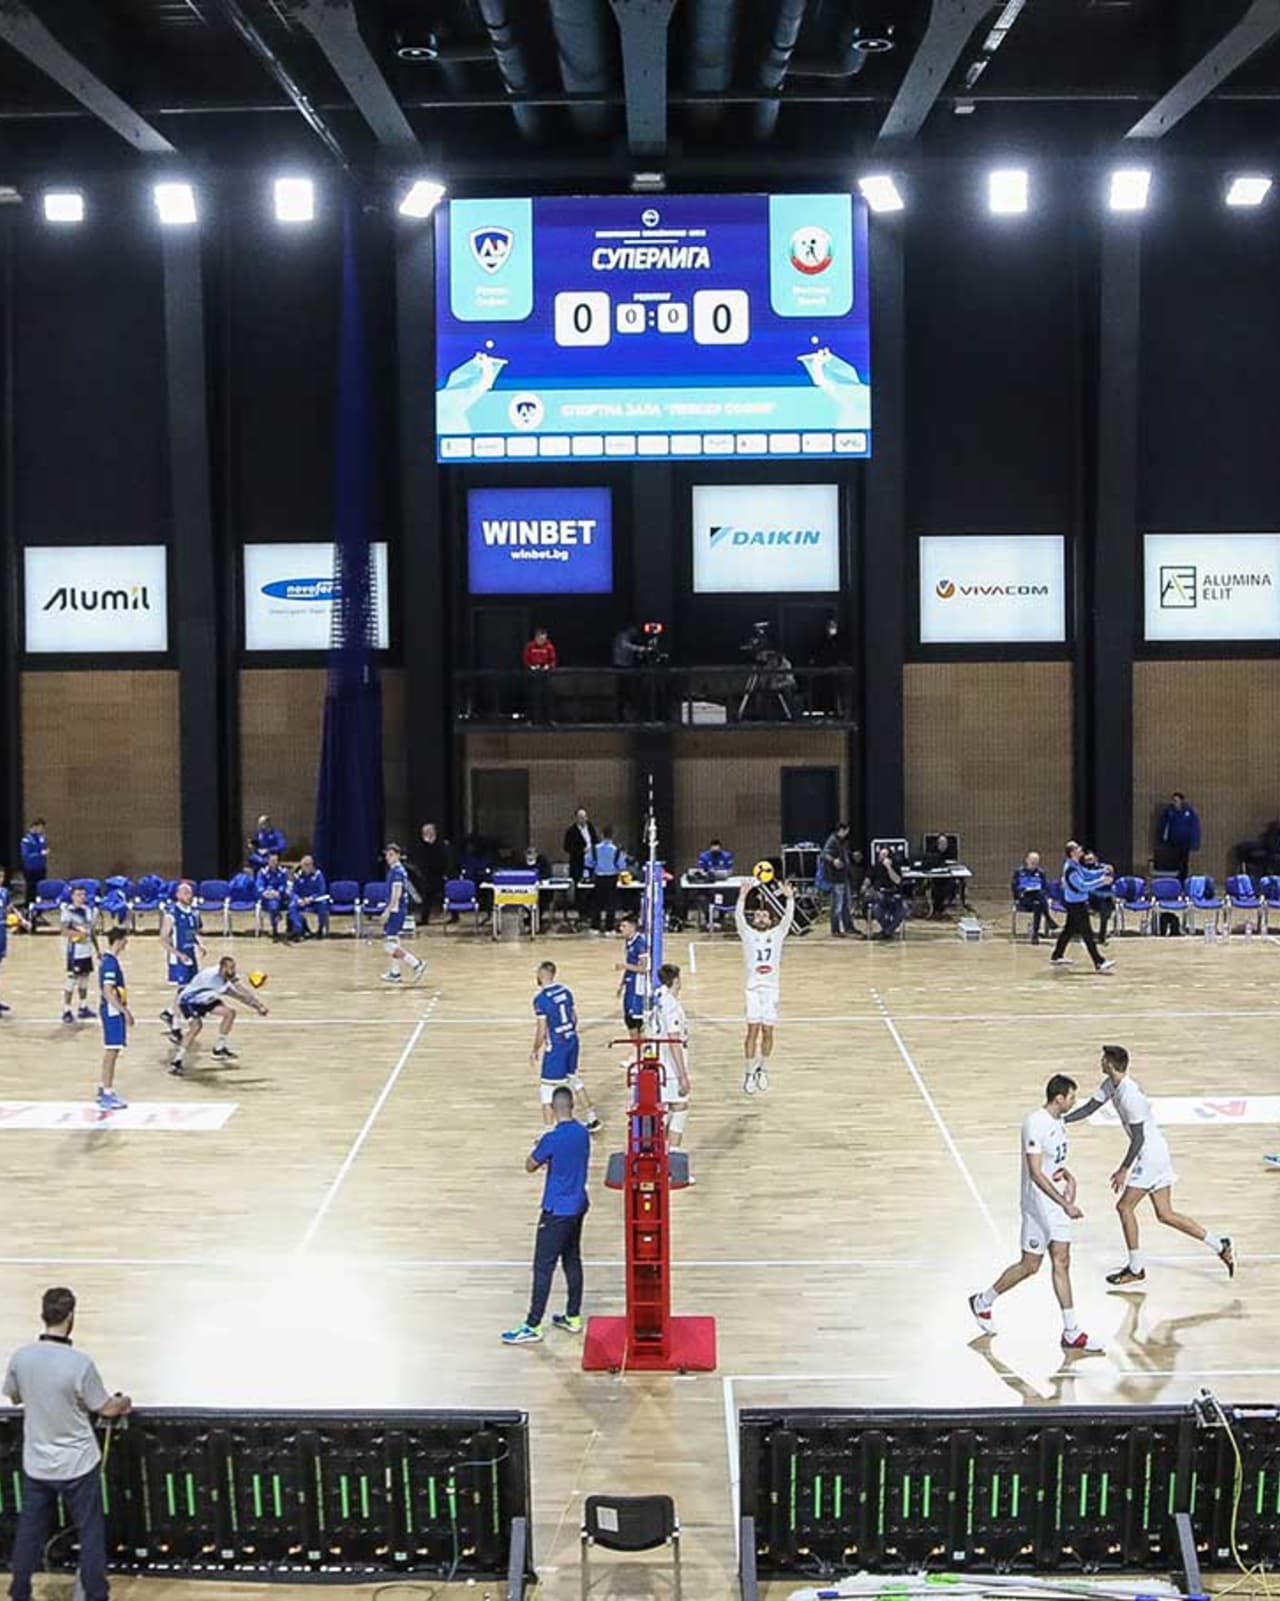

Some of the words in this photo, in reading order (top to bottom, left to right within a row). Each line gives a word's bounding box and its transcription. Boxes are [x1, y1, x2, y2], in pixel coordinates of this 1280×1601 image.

[592, 246, 711, 270] СУПЕРЛИГА
[573, 303, 592, 334] 0
[625, 308, 637, 325] 0
[667, 308, 679, 324] 0
[712, 303, 732, 334] 0
[482, 520, 597, 545] WINBET
[732, 530, 821, 545] DAIKIN
[511, 548, 569, 561] winbet.bg
[1202, 573, 1272, 587] ALUMINA
[43, 586, 150, 610] Alumil
[960, 585, 1048, 596] VIVACOM
[1202, 587, 1232, 601] ELIT
[756, 947, 772, 962] 17
